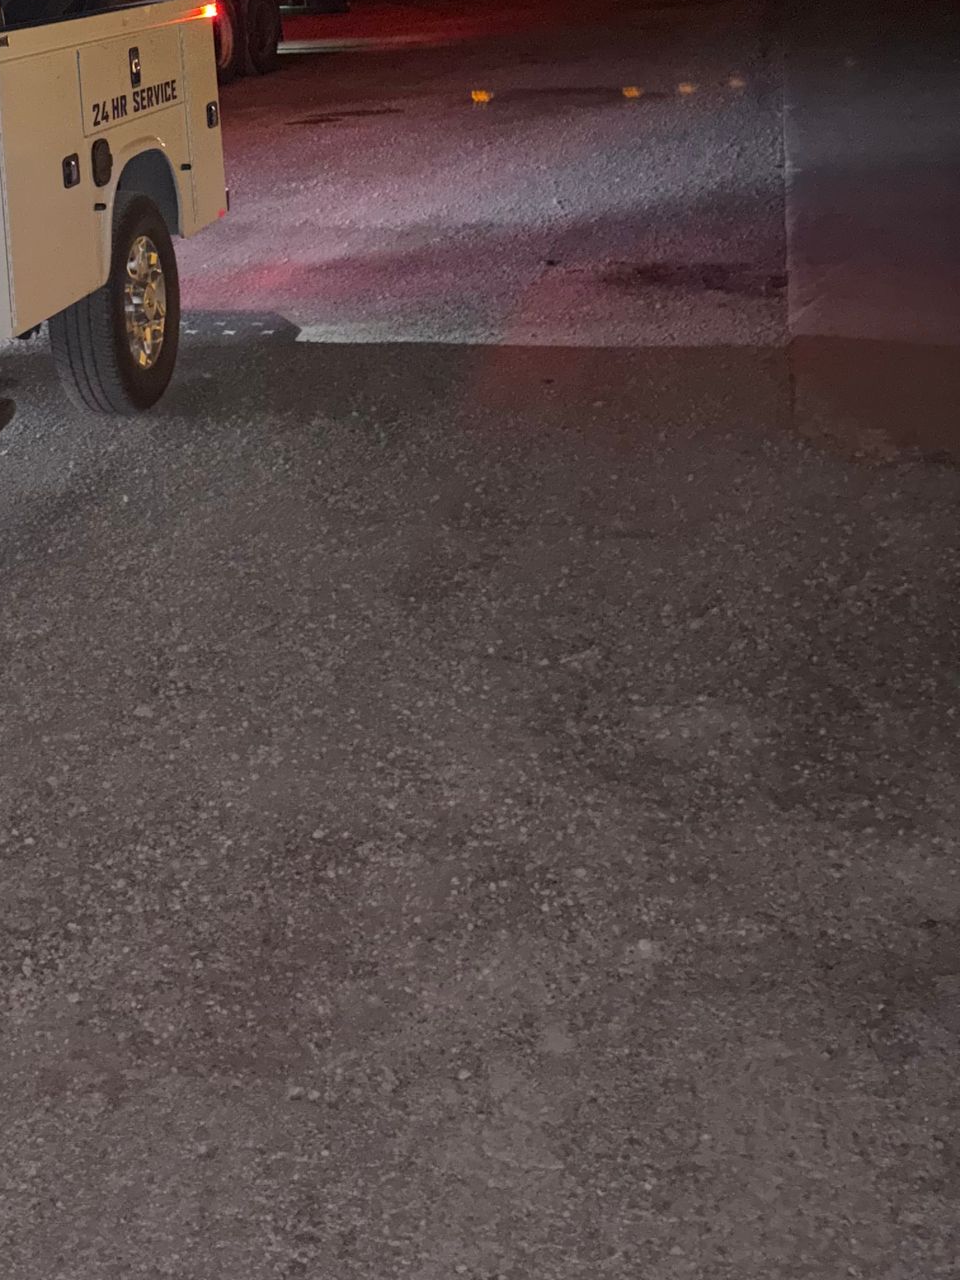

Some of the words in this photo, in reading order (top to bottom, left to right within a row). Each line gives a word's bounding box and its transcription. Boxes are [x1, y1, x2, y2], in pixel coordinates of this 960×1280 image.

[92, 102, 110, 127] 24
[112, 94, 128, 120] HR
[133, 79, 178, 113] SERVICE
